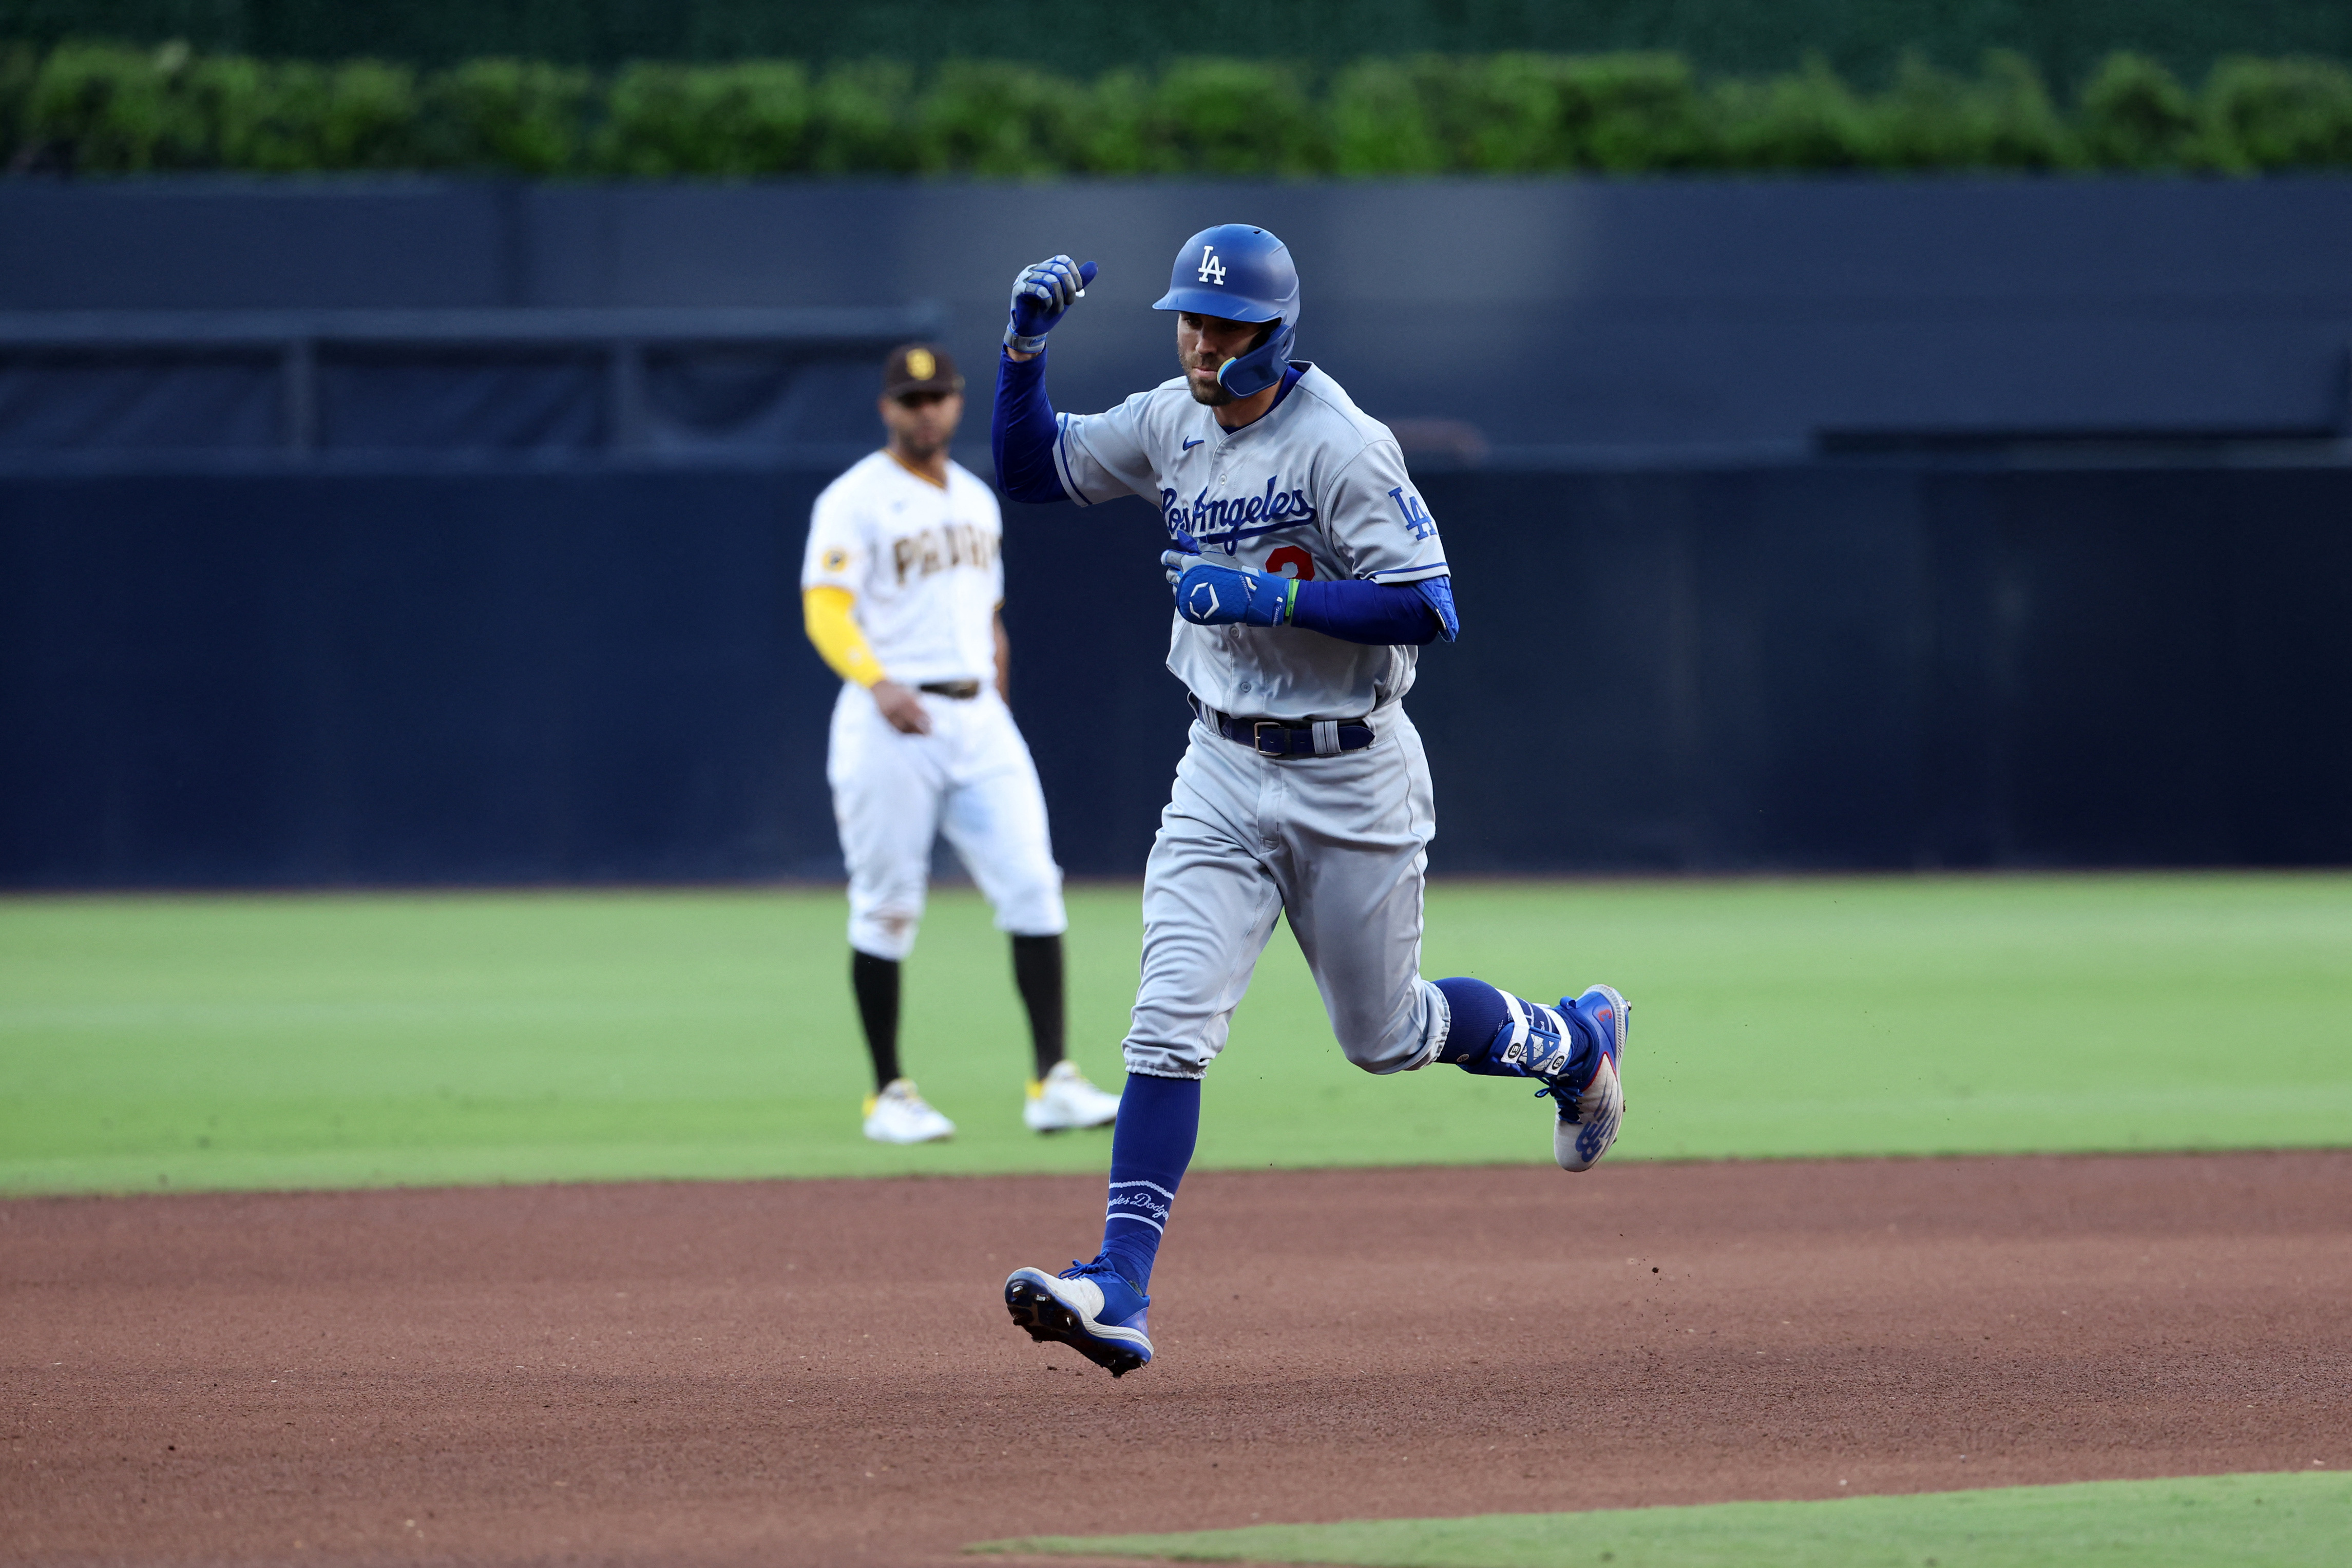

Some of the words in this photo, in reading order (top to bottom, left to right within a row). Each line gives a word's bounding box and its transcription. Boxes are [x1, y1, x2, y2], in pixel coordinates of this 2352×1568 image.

[1198, 245, 1227, 285] LA
[1192, 475, 1316, 557] Angeles
[1388, 486, 1438, 541] LA
